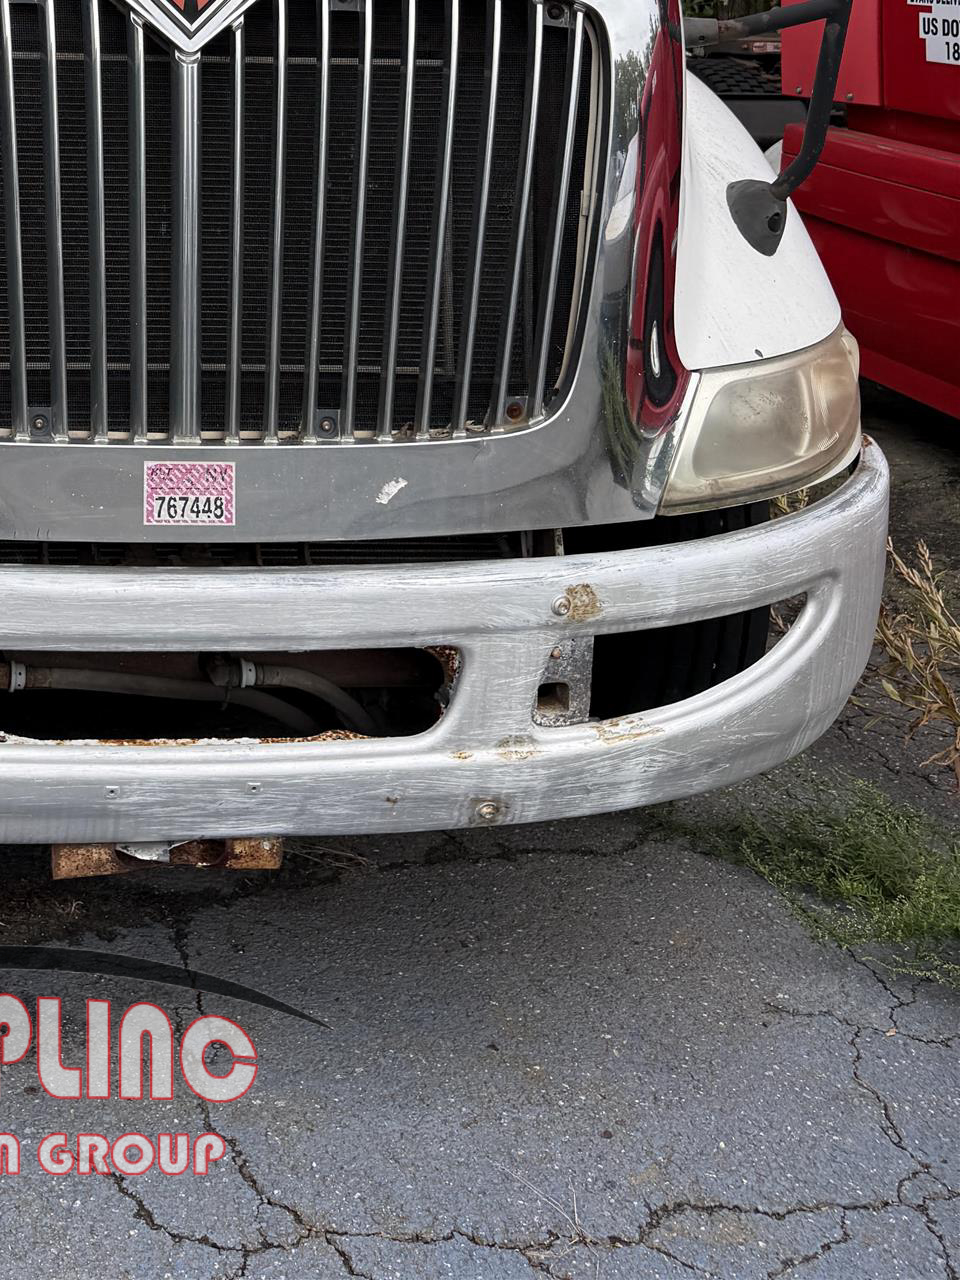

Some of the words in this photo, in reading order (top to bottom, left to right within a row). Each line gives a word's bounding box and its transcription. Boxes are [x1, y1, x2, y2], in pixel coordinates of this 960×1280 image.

[922, 17, 939, 36] US
[942, 19, 960, 38] DO
[155, 496, 224, 519] 767448
